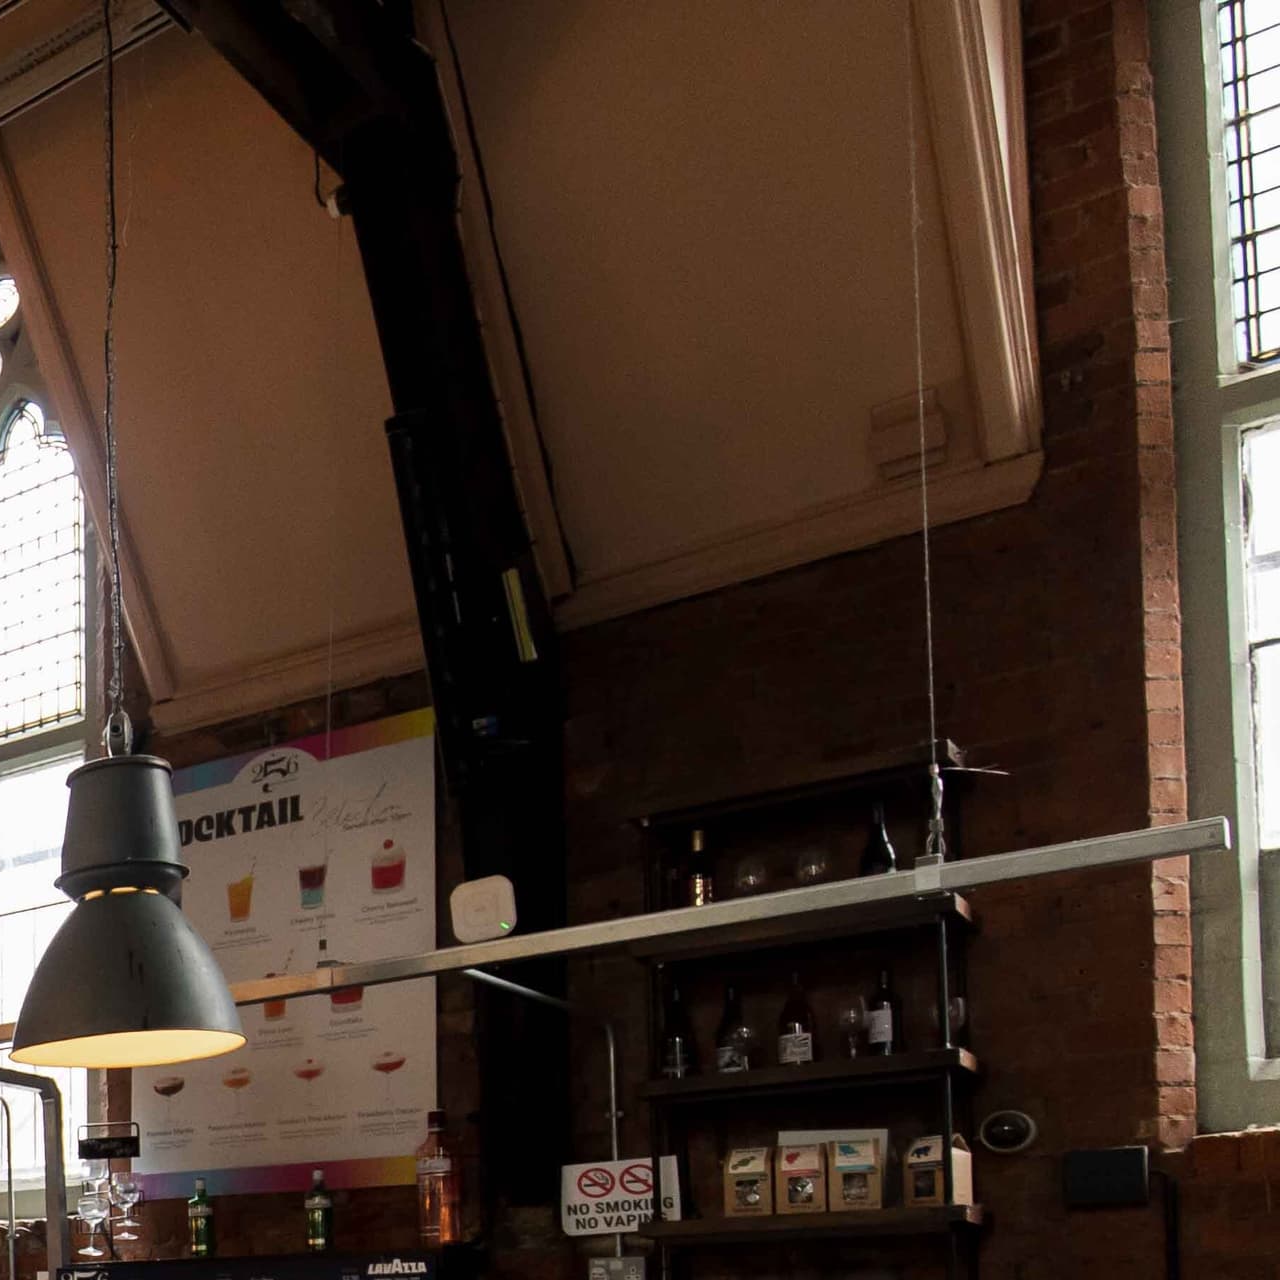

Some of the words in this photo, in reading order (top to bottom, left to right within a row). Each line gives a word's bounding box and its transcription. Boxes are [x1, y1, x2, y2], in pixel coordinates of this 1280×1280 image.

[178, 795, 304, 846] OCKTAIL
[567, 1203, 590, 1216] NO
[595, 1196, 674, 1214] SMOKIG
[575, 1216, 598, 1230] NO
[367, 1257, 428, 1275] LAVAZZA
